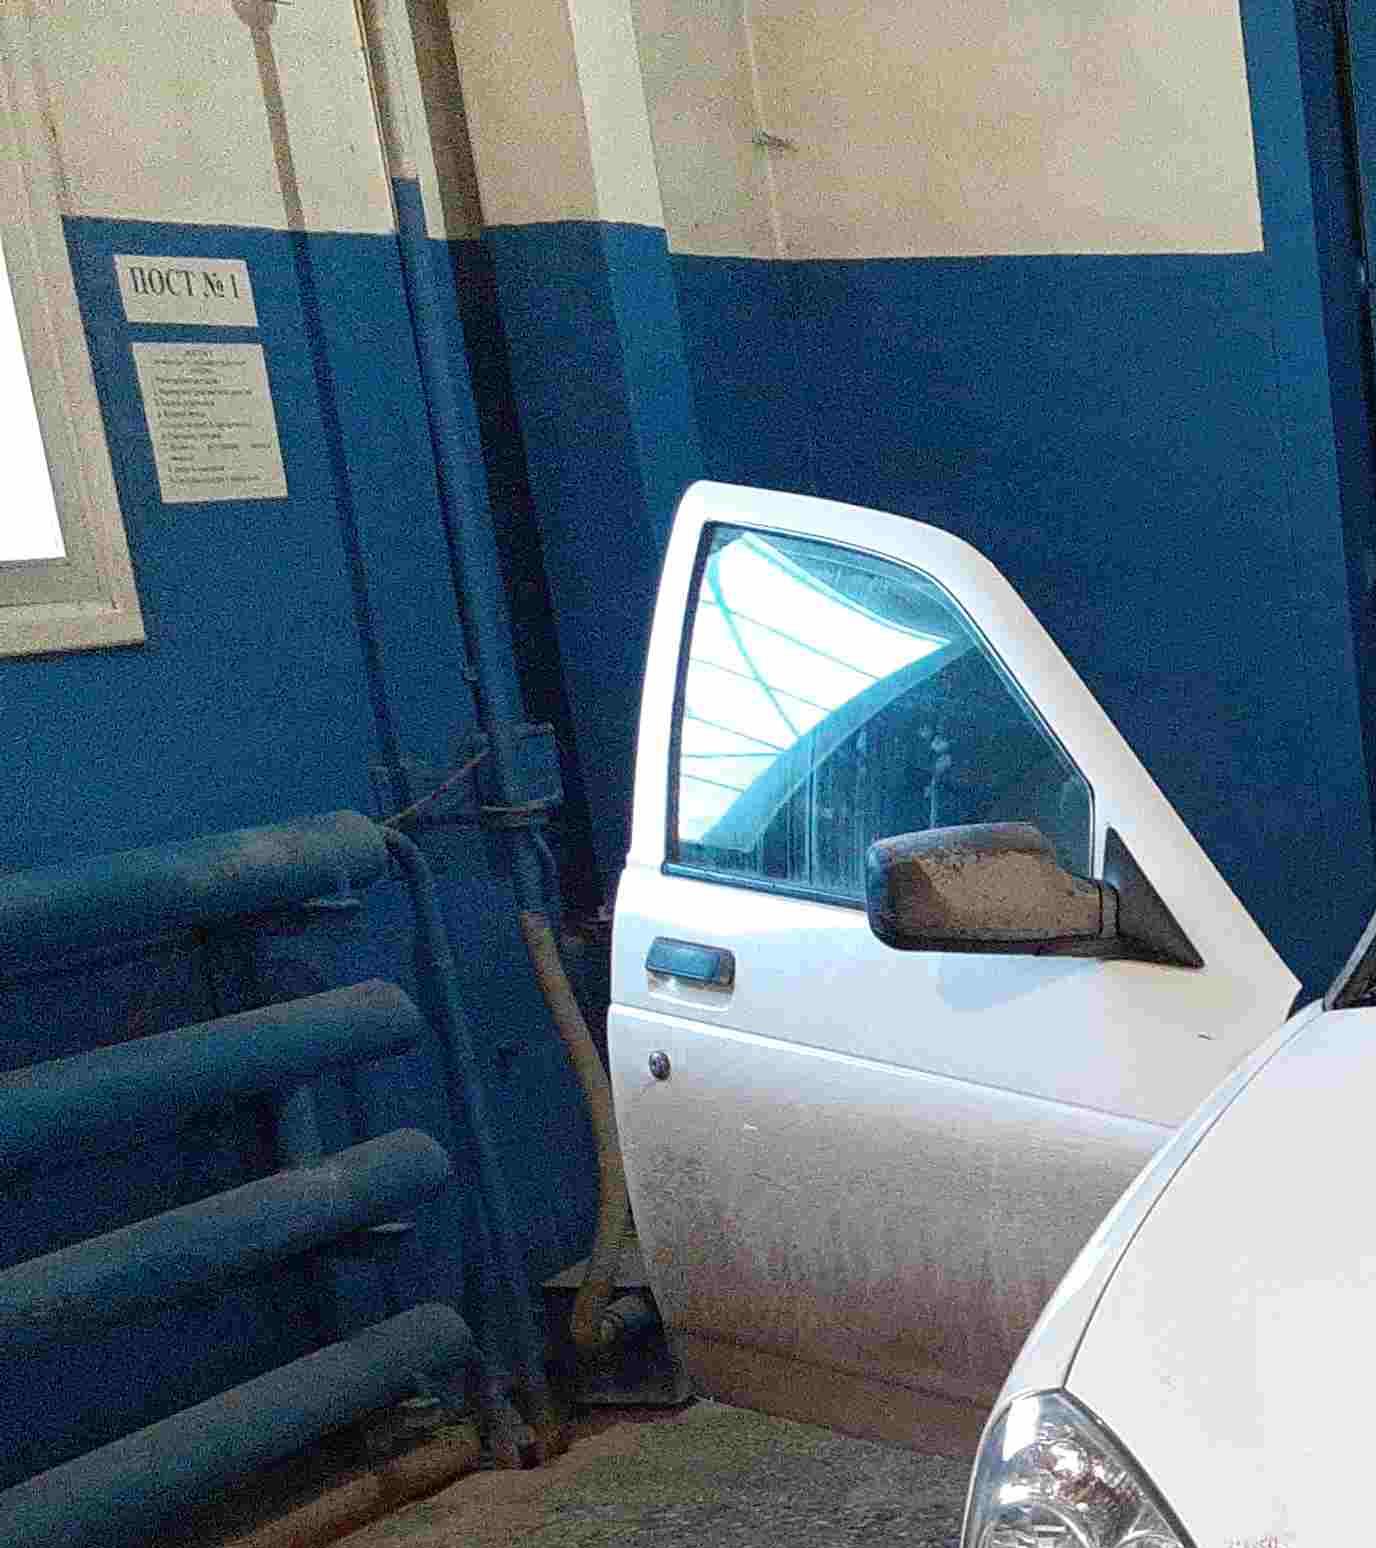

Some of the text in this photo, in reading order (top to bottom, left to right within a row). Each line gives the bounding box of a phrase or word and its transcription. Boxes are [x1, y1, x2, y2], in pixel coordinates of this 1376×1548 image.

[130, 267, 240, 299] ПОСТ № 1
